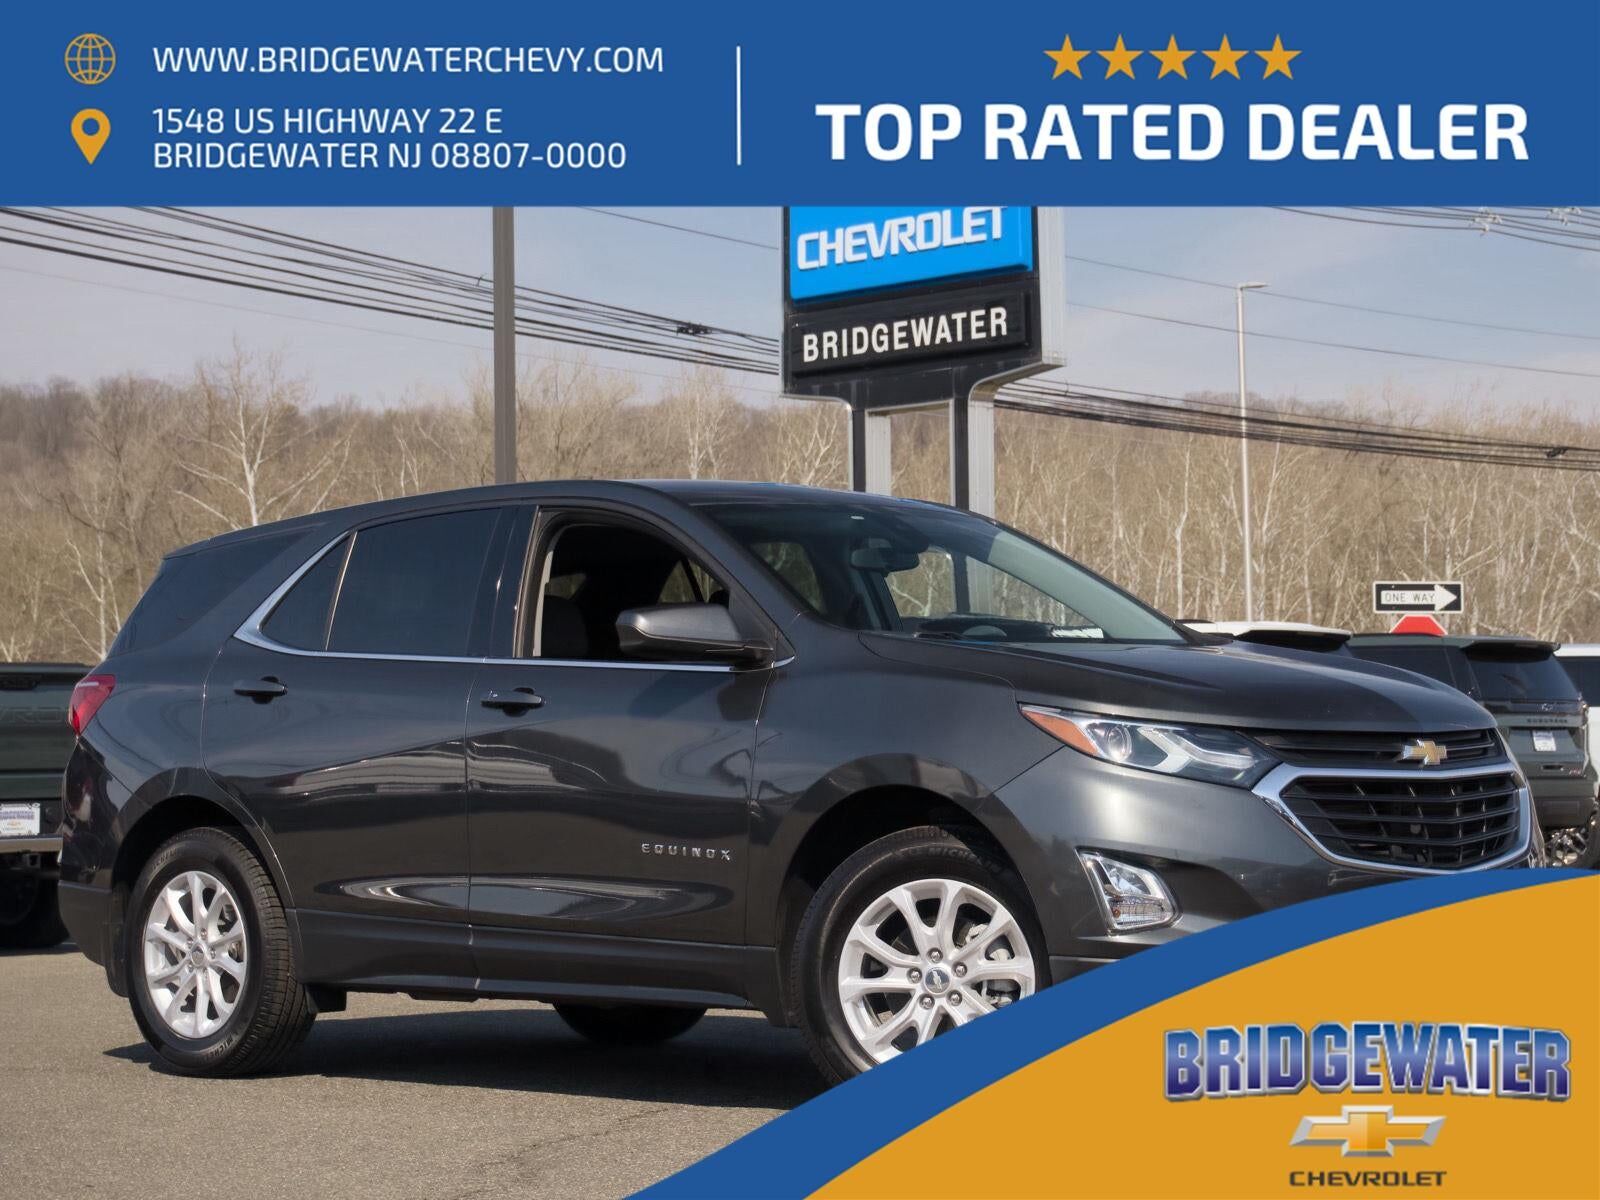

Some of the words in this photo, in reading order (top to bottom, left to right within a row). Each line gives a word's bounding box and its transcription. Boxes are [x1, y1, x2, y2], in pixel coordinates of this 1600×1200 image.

[797, 206, 1008, 270] CHEVROLET
[803, 306, 1008, 363] BRIDGEWATER
[1384, 592, 1406, 602] ONE
[1412, 592, 1435, 603] WAY
[641, 843, 731, 861] EQUINOX
